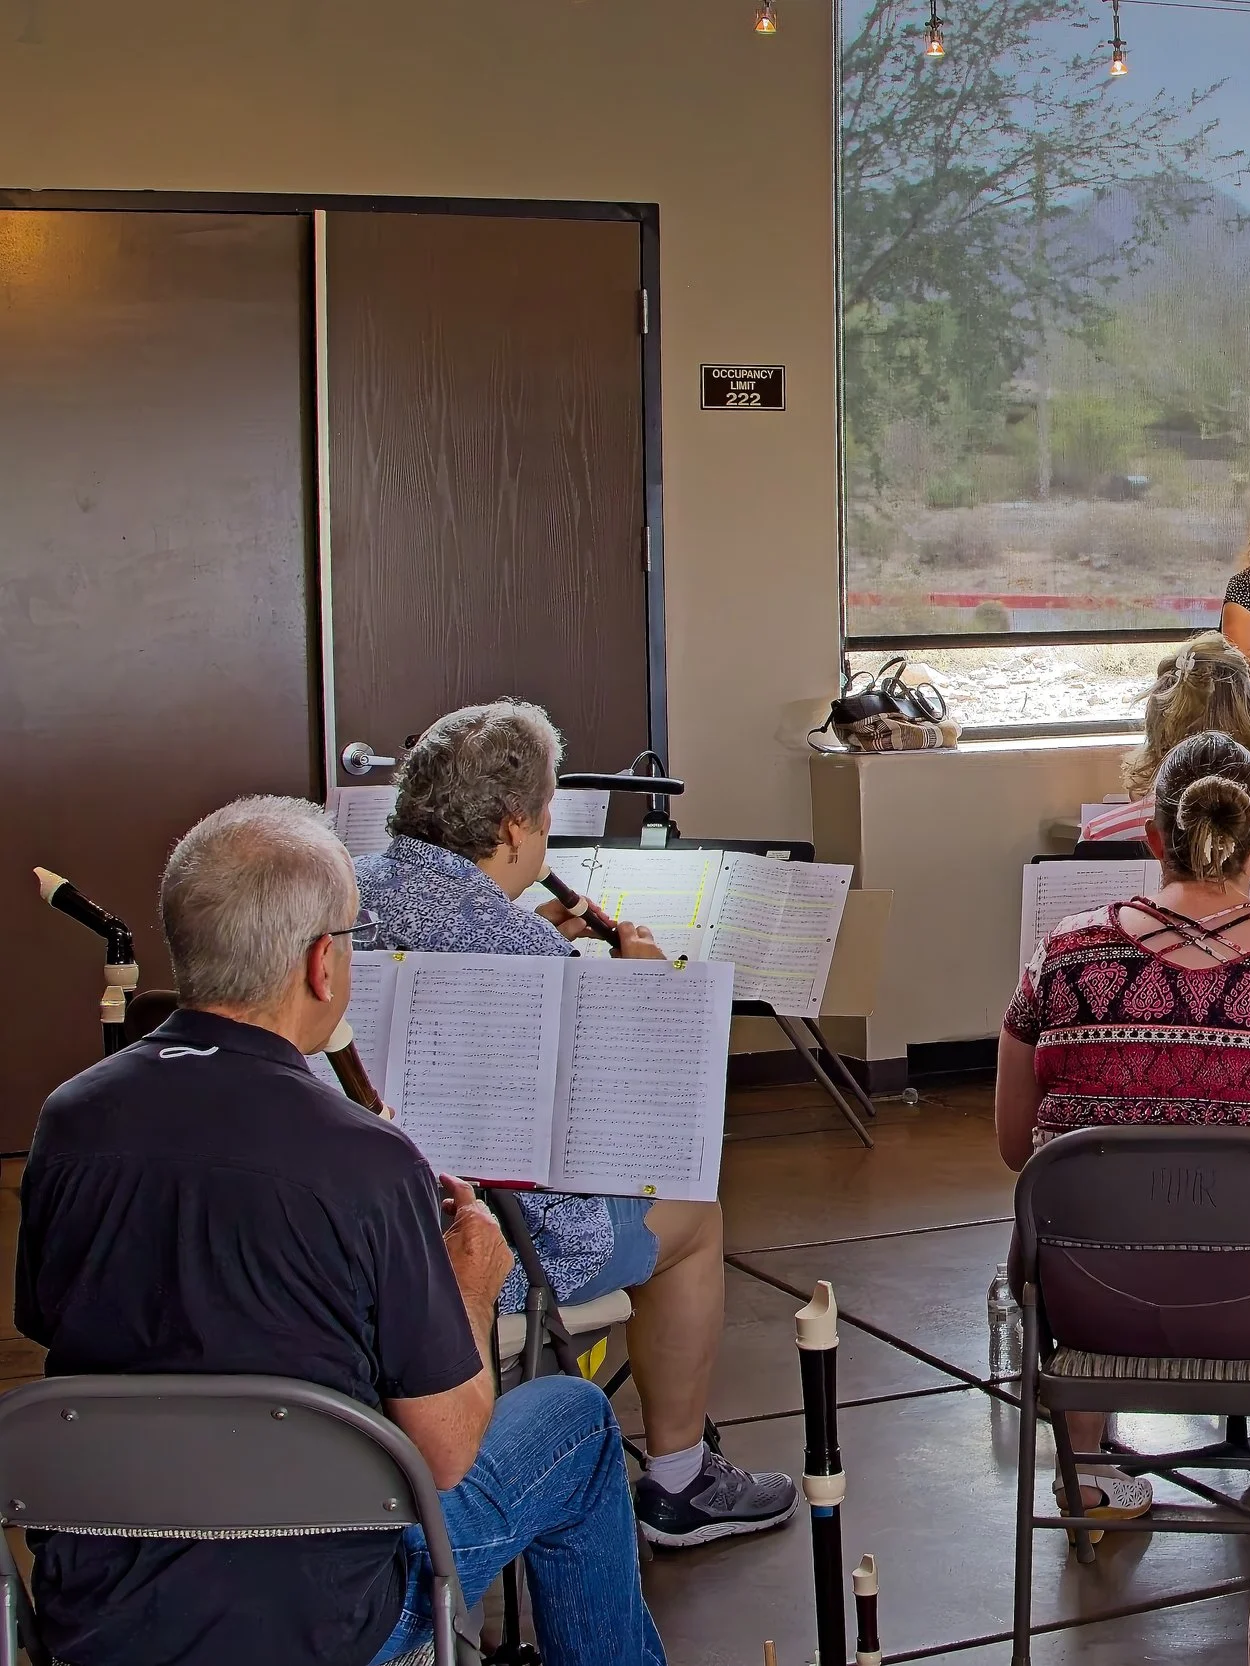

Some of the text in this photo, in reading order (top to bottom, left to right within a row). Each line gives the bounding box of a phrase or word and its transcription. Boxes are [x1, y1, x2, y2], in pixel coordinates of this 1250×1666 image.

[712, 368, 774, 379] OCCUPANCY
[730, 380, 756, 390] LIMIT
[725, 392, 761, 406] 222
